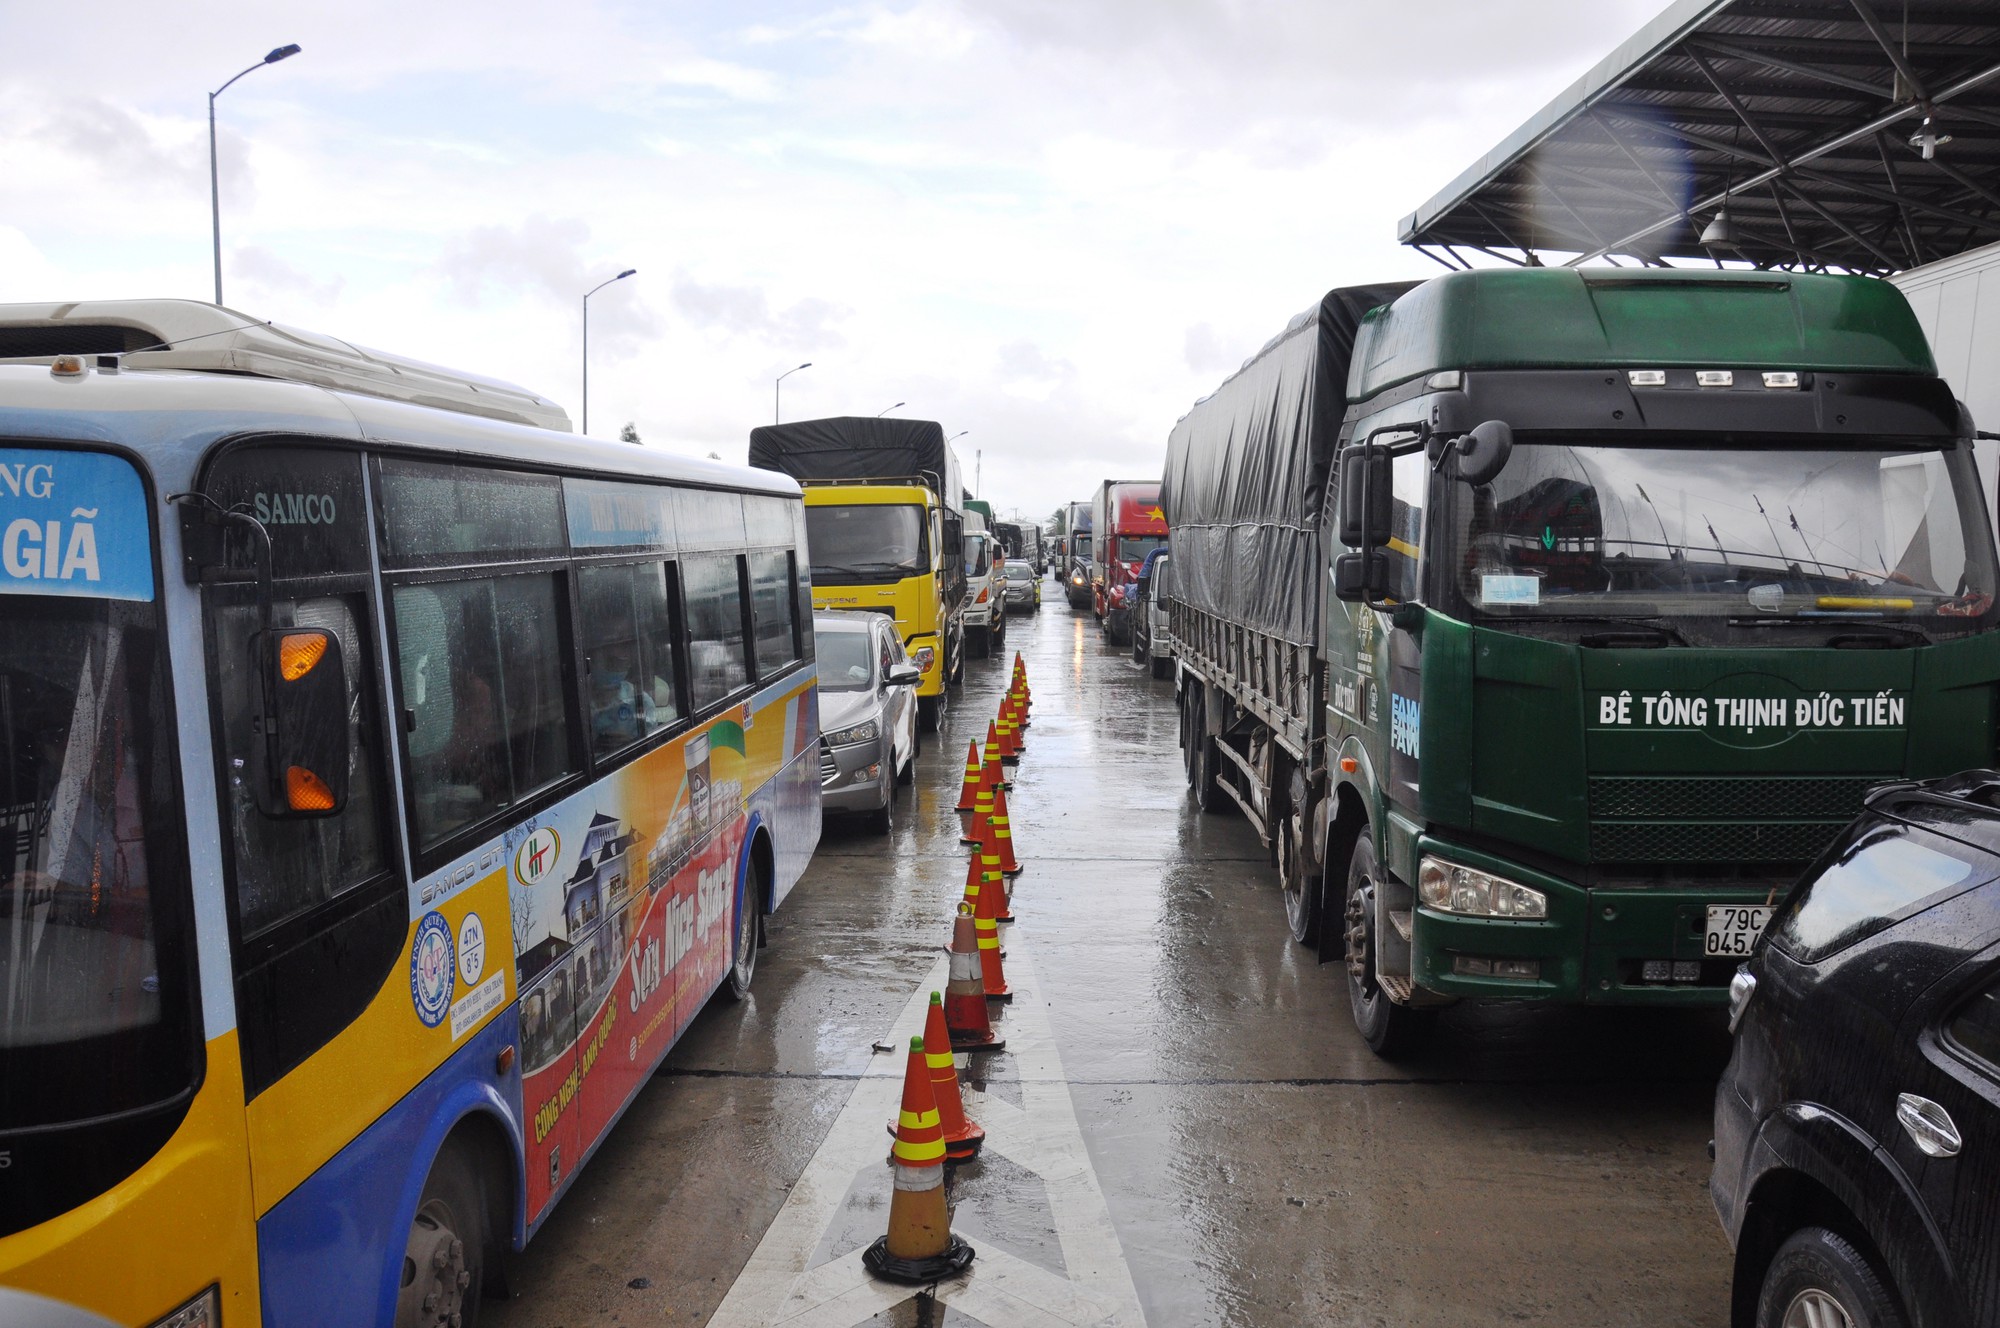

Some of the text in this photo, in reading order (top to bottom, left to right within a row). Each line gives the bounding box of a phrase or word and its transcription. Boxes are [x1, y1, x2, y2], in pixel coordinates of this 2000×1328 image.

[254, 492, 336, 524] SAMCO
[3, 507, 100, 581] GIÃ
[812, 597, 858, 605] ONGFENG
[1600, 689, 1904, 734] BÊ TÔNG THỊNH ĐỨC TIẾN
[421, 845, 505, 906] SAMCO CIT
[463, 925, 478, 946] 47N
[664, 892, 694, 977] Nice
[697, 856, 732, 945] Space
[1724, 909, 1762, 930] 79C
[534, 1095, 559, 1144] CÔNG
[583, 1036, 598, 1078] ANH
